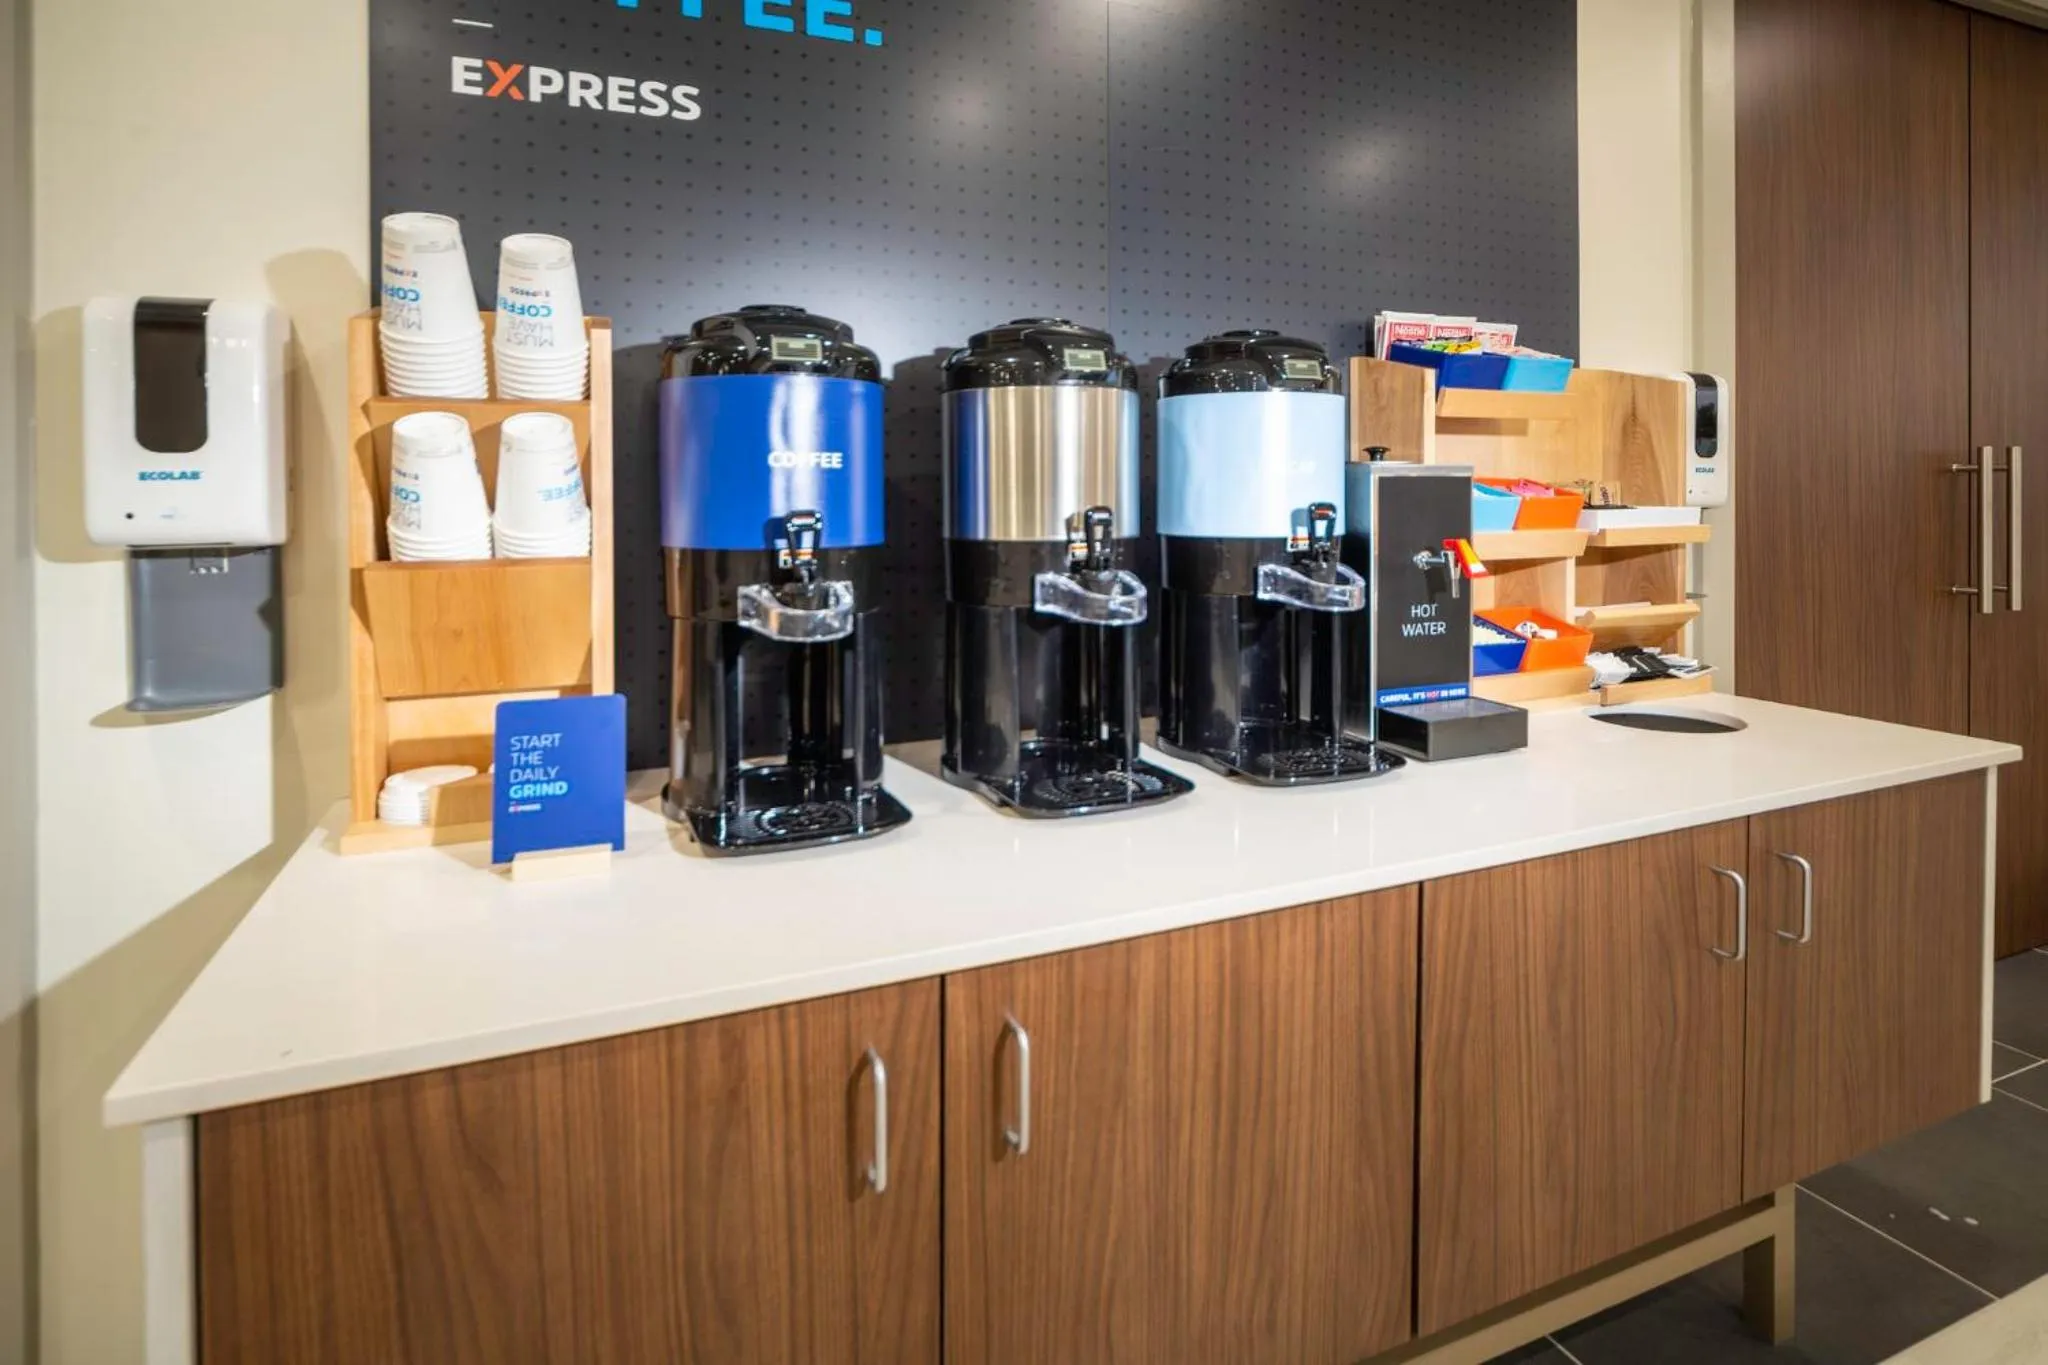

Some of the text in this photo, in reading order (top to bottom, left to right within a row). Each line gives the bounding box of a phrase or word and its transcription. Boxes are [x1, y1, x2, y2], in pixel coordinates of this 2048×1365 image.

[617, 0, 883, 46] EE.
[451, 55, 702, 121] EXPRESS
[139, 471, 201, 481] ECOLAB
[1411, 603, 1440, 619] HOT
[1402, 621, 1447, 637] WATER
[510, 733, 563, 751] START
[510, 750, 544, 766] THE
[509, 765, 560, 784] DAILY
[509, 781, 568, 799] GRIND
